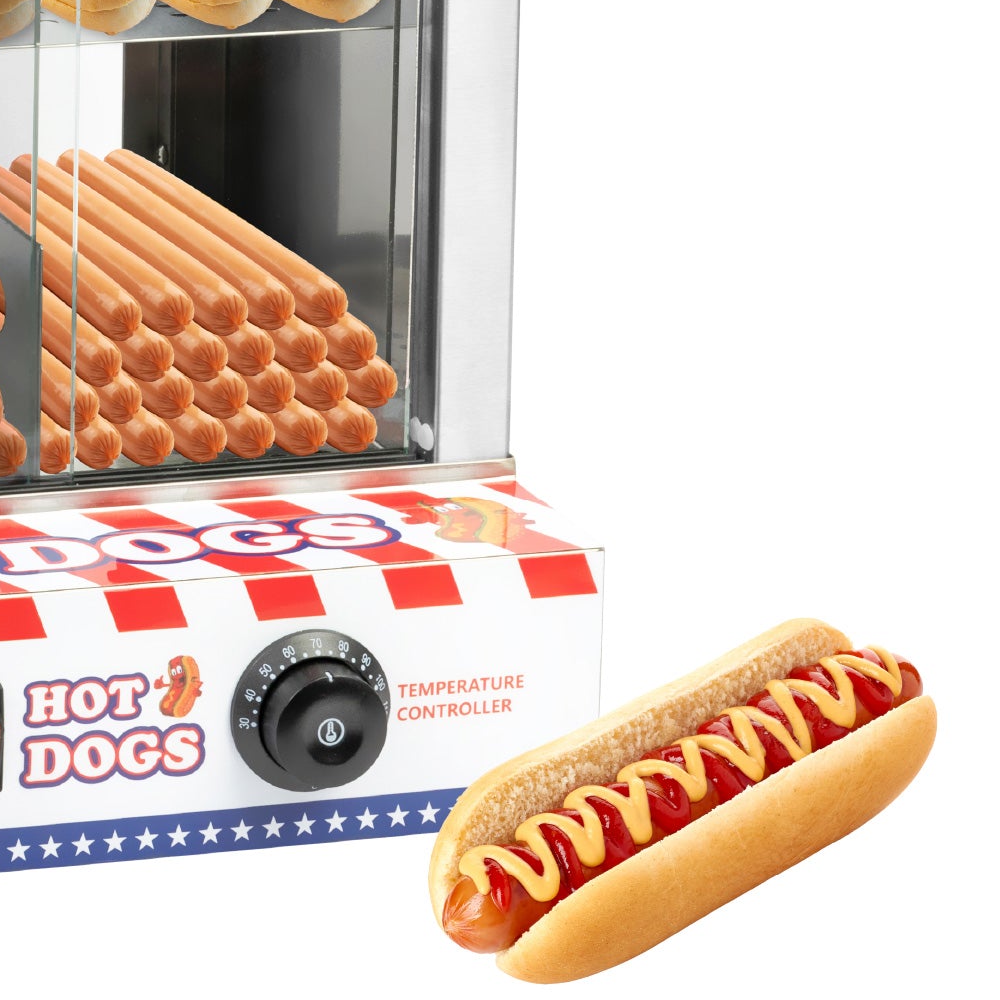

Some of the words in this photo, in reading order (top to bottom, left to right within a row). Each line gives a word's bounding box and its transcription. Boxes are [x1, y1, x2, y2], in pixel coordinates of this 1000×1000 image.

[310, 637, 322, 649] 70
[338, 639, 349, 652] 80
[282, 645, 296, 659] 60
[361, 653, 371, 667] 90
[258, 663, 272, 677] 50
[375, 674, 386, 691] 100
[397, 674, 525, 699] TEMPERATURE
[25, 674, 148, 726] HOT
[244, 689, 257, 702] 40
[396, 698, 512, 722] CONTROLLER
[238, 717, 250, 730] 30
[21, 725, 203, 787] DOGS
